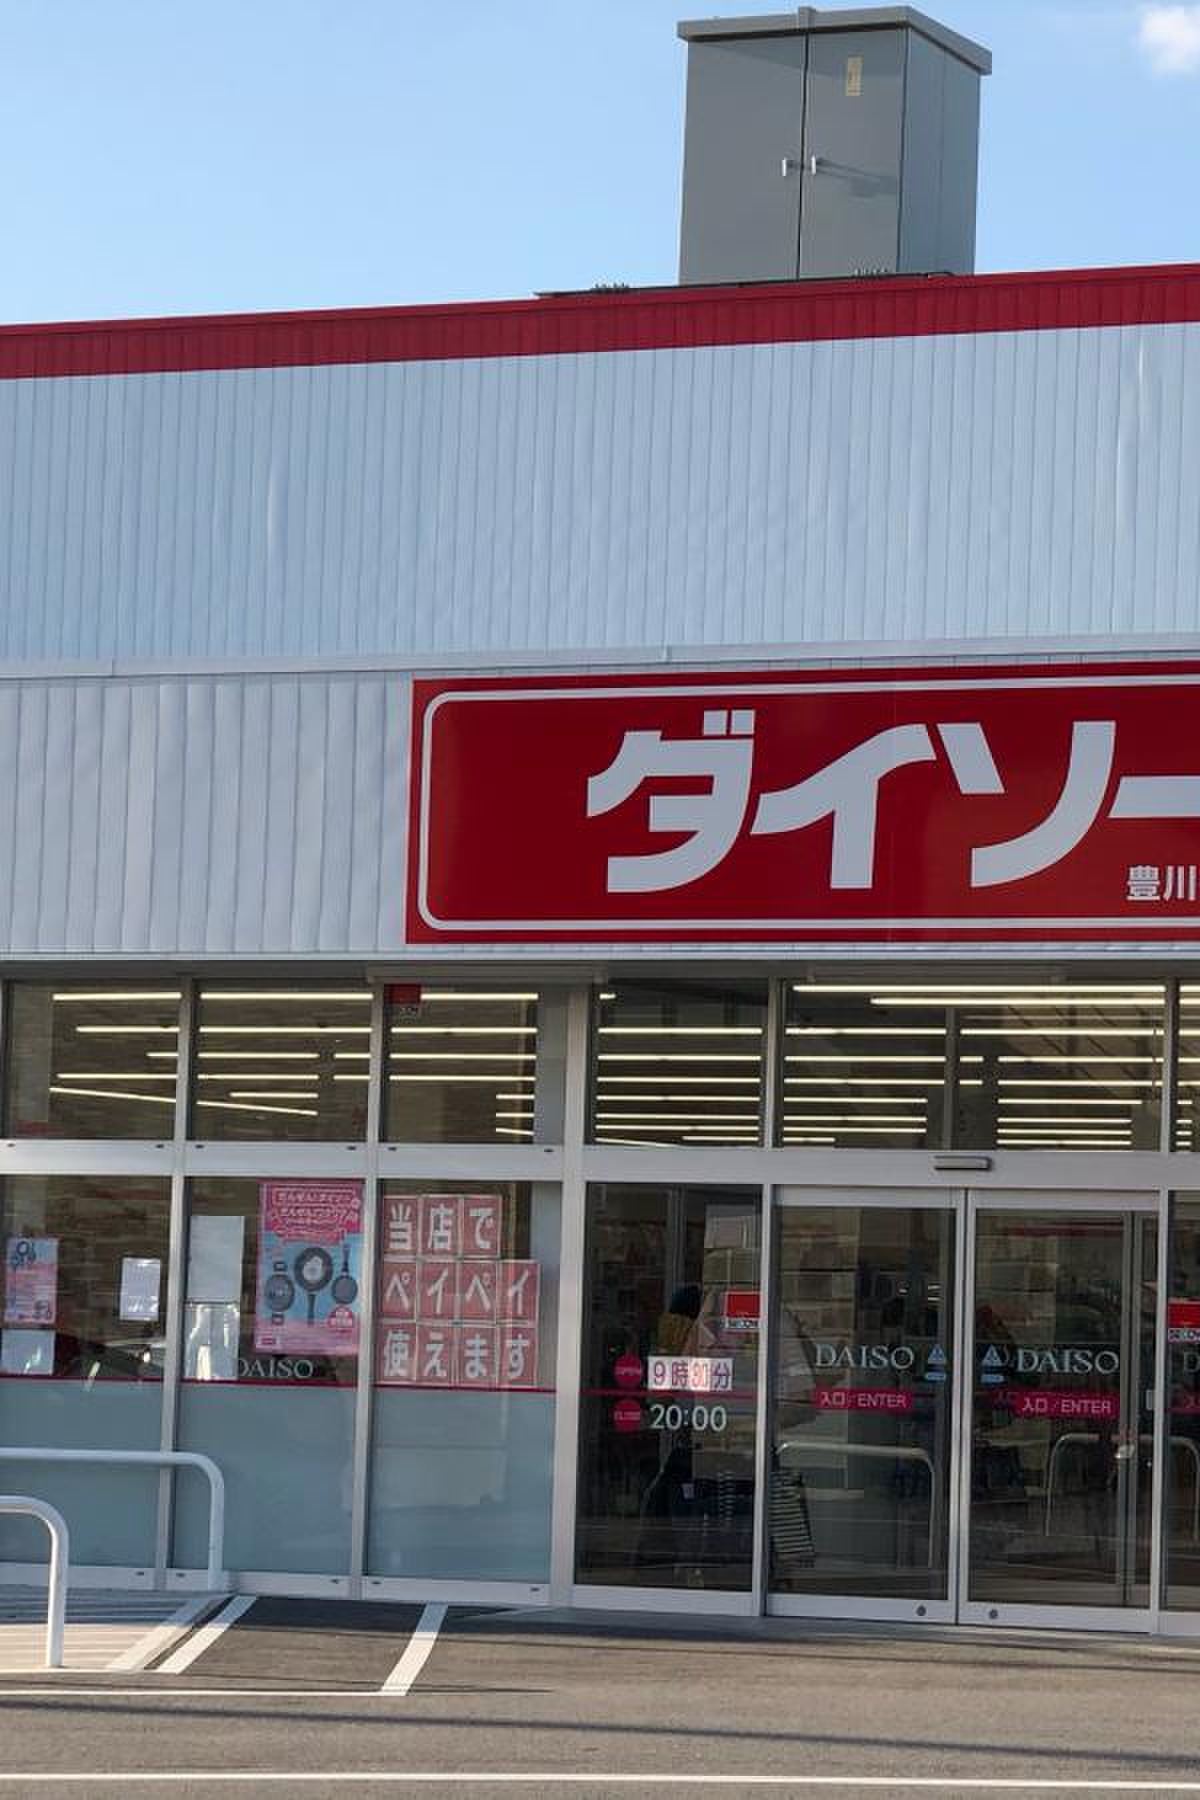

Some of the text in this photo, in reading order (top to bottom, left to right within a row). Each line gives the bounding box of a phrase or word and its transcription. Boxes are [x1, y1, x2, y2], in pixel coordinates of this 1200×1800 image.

[389, 1202, 495, 1251] 当店で
[384, 1267, 530, 1316] ペイペイ
[384, 1328, 530, 1379] 使えます
[816, 1344, 914, 1370] DAISO
[1017, 1348, 1119, 1374] DAISO
[858, 1392, 907, 1408] ENTER
[1060, 1399, 1111, 1414] ENTER
[651, 1404, 727, 1432] 20:00
